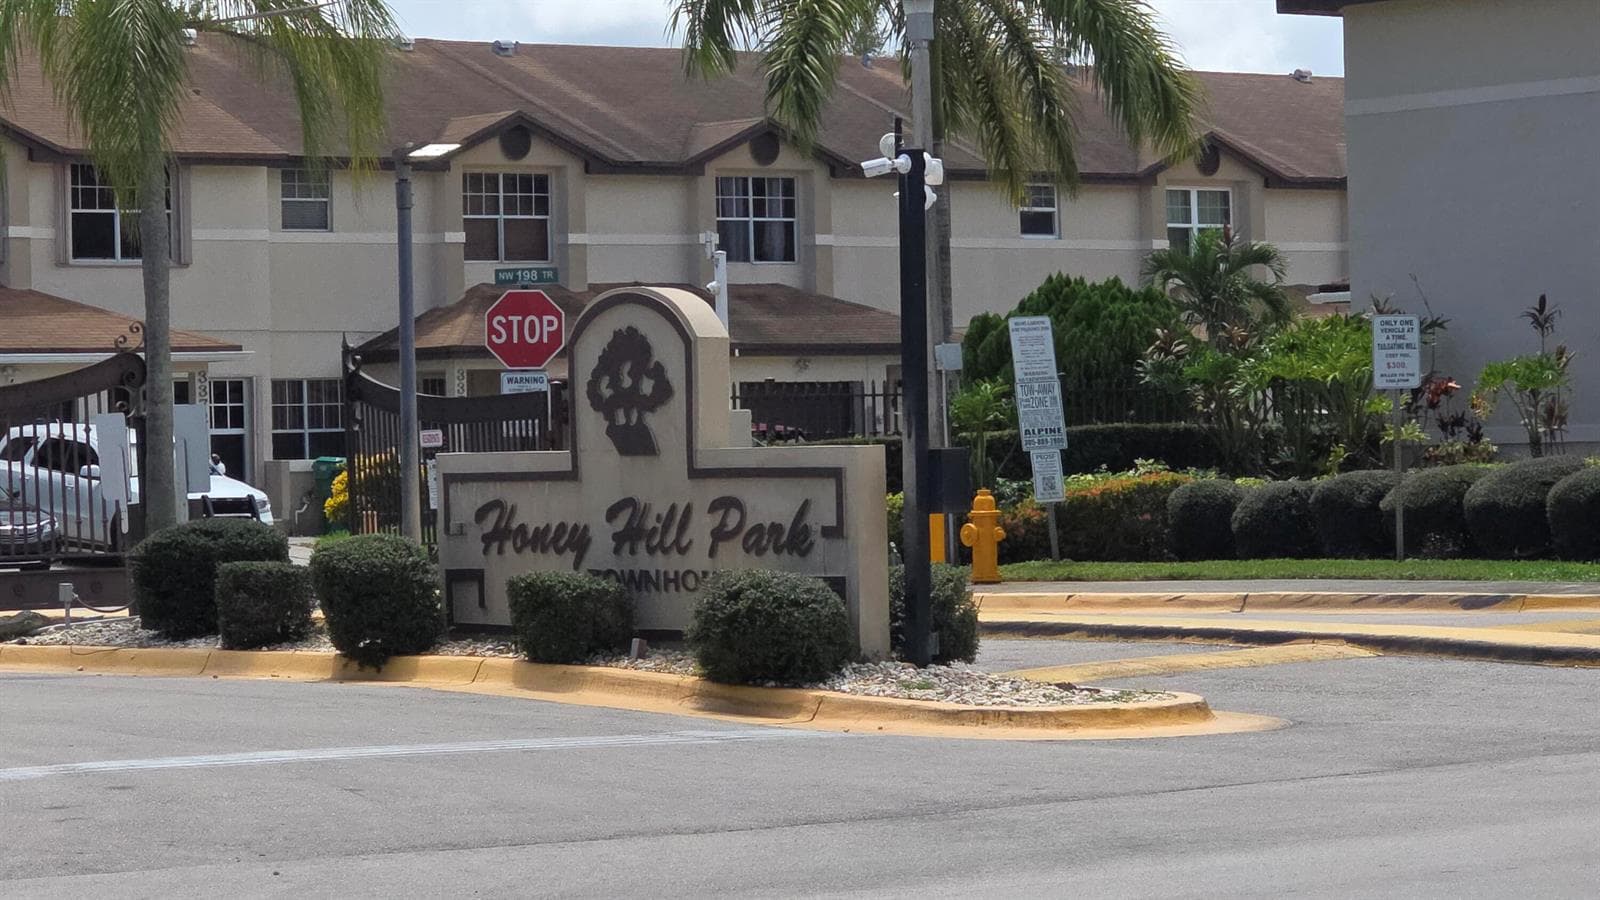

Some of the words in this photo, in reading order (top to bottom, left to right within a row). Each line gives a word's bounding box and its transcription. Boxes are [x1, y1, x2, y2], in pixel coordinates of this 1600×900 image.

[498, 272, 513, 280] NW
[517, 270, 538, 281] 198
[543, 271, 554, 279] TR
[491, 315, 558, 344] STOP
[506, 376, 545, 385] WARNING
[1019, 383, 1055, 397] TOW-AWAY
[1030, 396, 1048, 409] ZONE
[1024, 427, 1063, 436] ALPINE
[474, 498, 592, 570] Honey
[605, 496, 693, 557] Hill
[707, 495, 815, 559] Park
